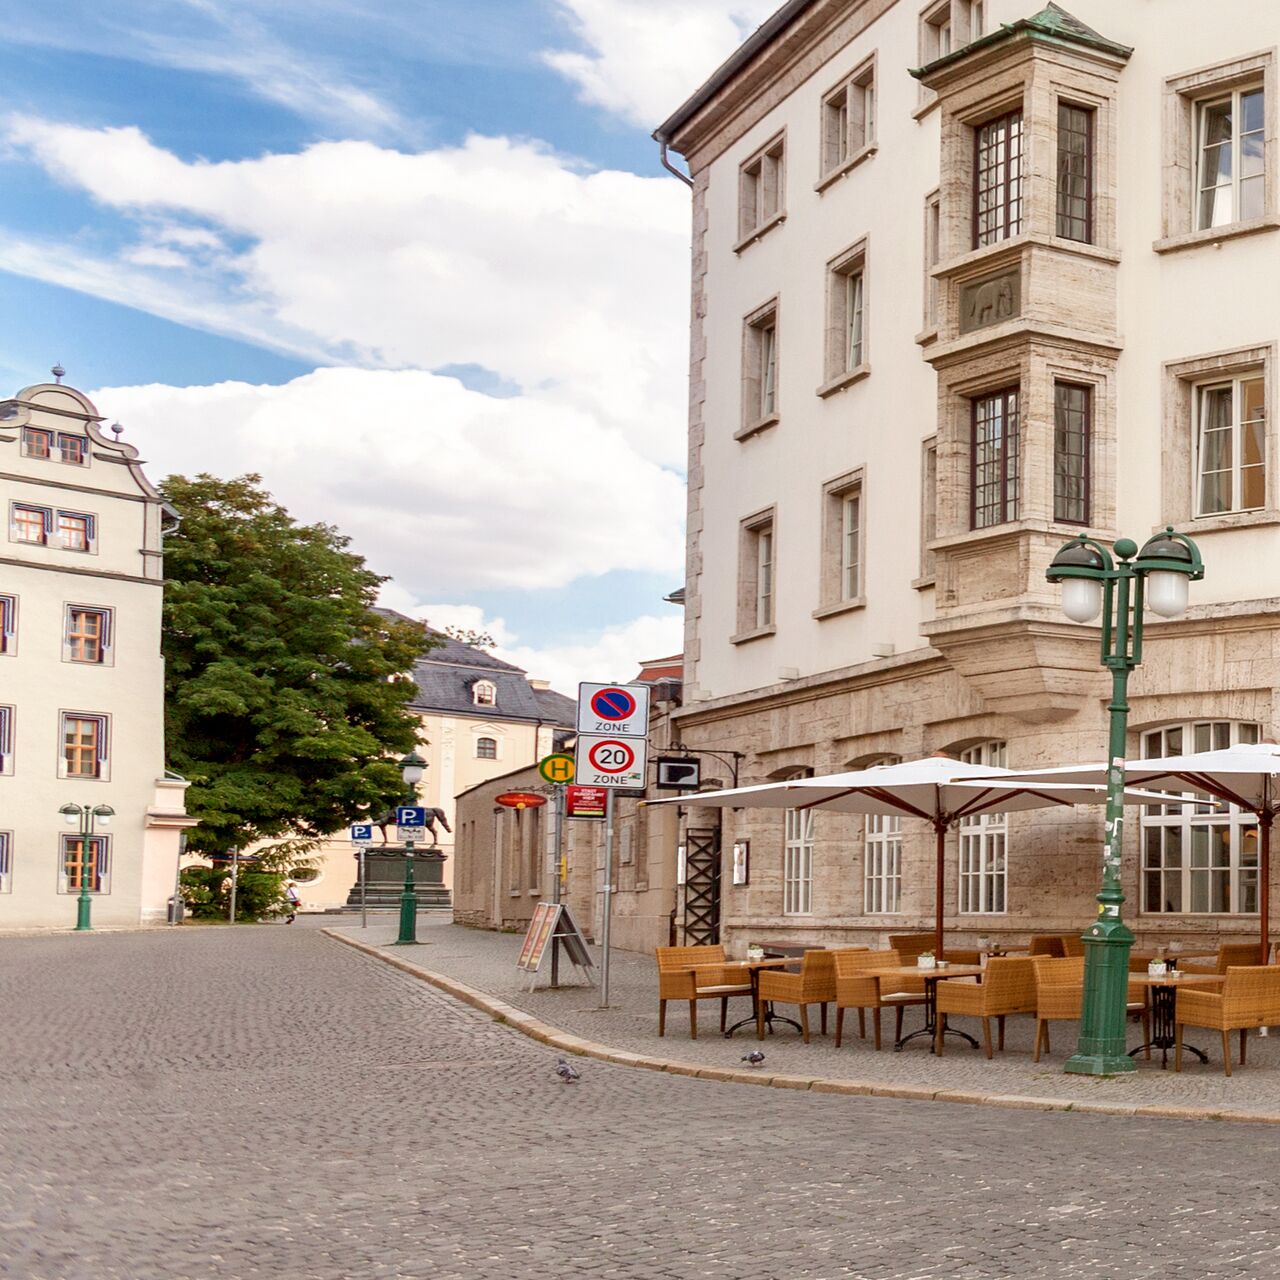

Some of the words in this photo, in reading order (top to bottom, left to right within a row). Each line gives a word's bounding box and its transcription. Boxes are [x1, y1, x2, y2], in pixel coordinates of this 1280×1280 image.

[595, 721, 630, 733] ZONE
[599, 749, 626, 765] 20
[552, 760, 569, 778] H
[593, 774, 628, 785] ZONE
[401, 809, 417, 824] P
[354, 826, 366, 837] P
